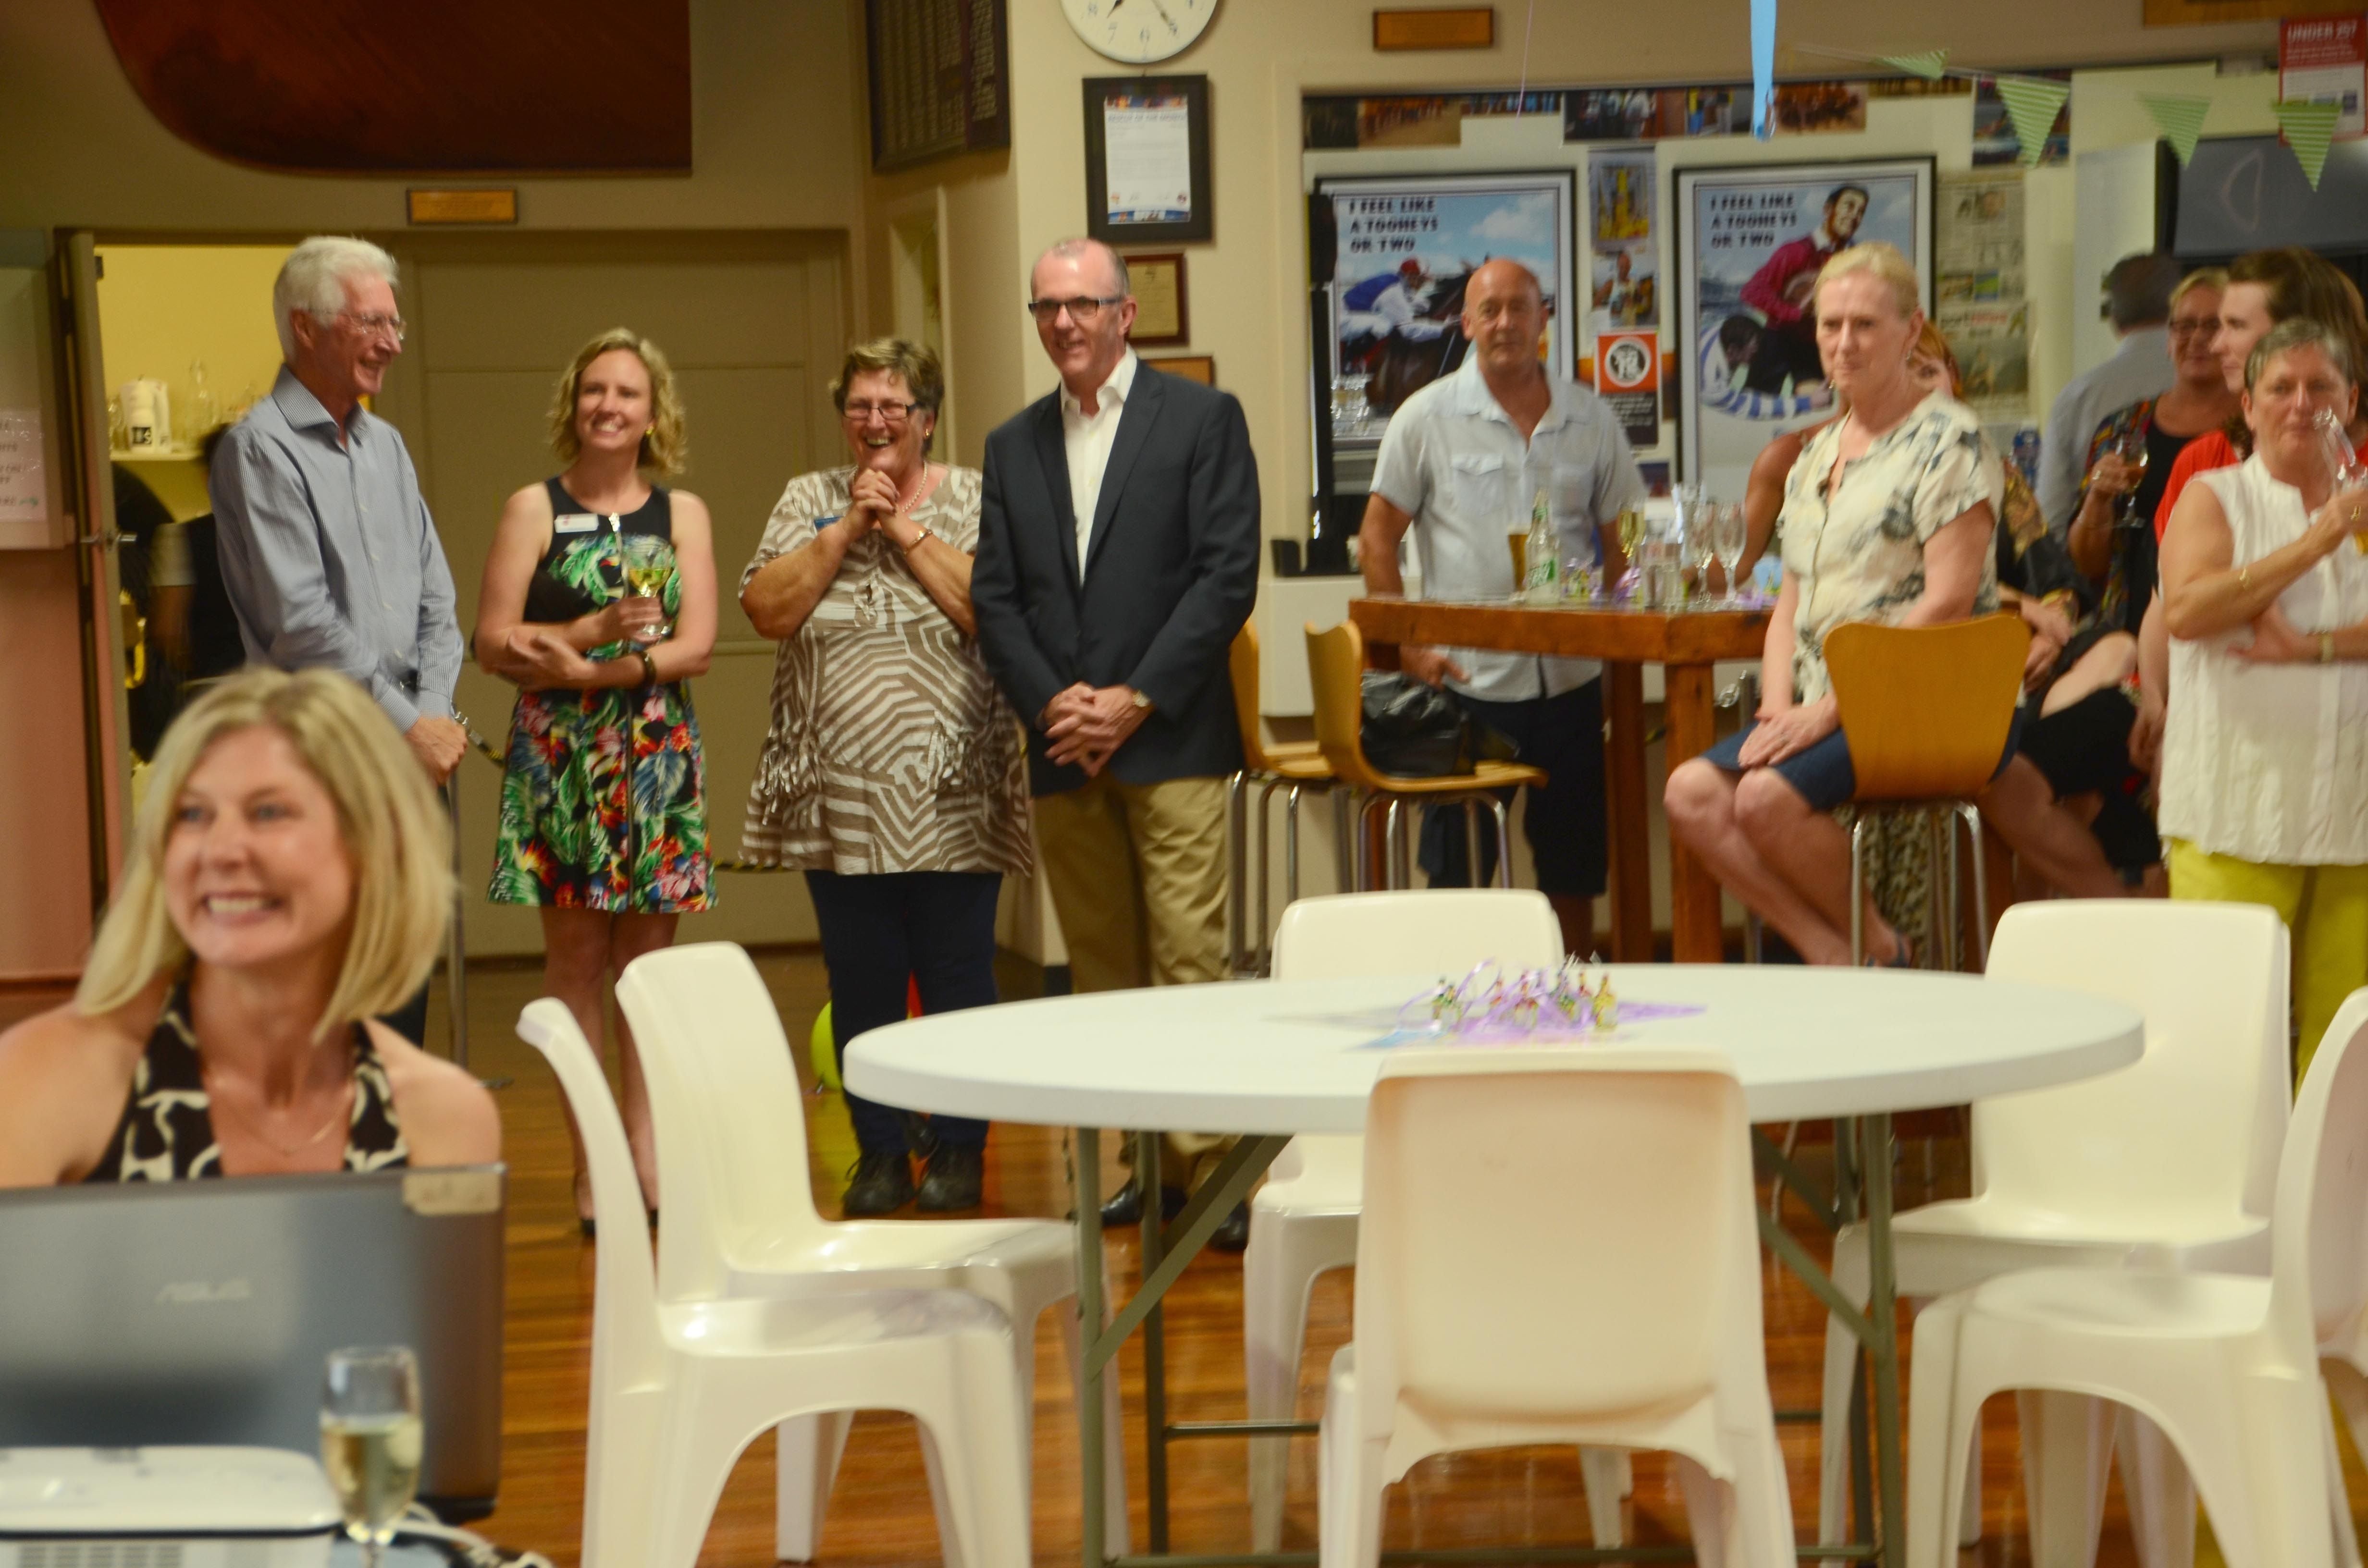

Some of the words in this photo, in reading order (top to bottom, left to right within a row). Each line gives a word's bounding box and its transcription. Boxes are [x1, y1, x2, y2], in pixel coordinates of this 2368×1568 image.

[1349, 198, 1355, 214] I
[1360, 197, 1393, 214] FEEL
[1400, 196, 1435, 213] LIKE
[1711, 194, 1716, 210] I
[1721, 193, 1753, 210] FEEL
[1761, 192, 1794, 209] LIKE
[1350, 217, 1360, 234] A
[1365, 216, 1438, 233] TOOHEYS
[1711, 213, 1721, 230] A
[1727, 210, 1797, 229] TOOHEYS
[1350, 238, 1372, 254] OR
[1378, 236, 1416, 253] TWO
[1712, 232, 1732, 249] OR
[1739, 230, 1775, 248] TWO
